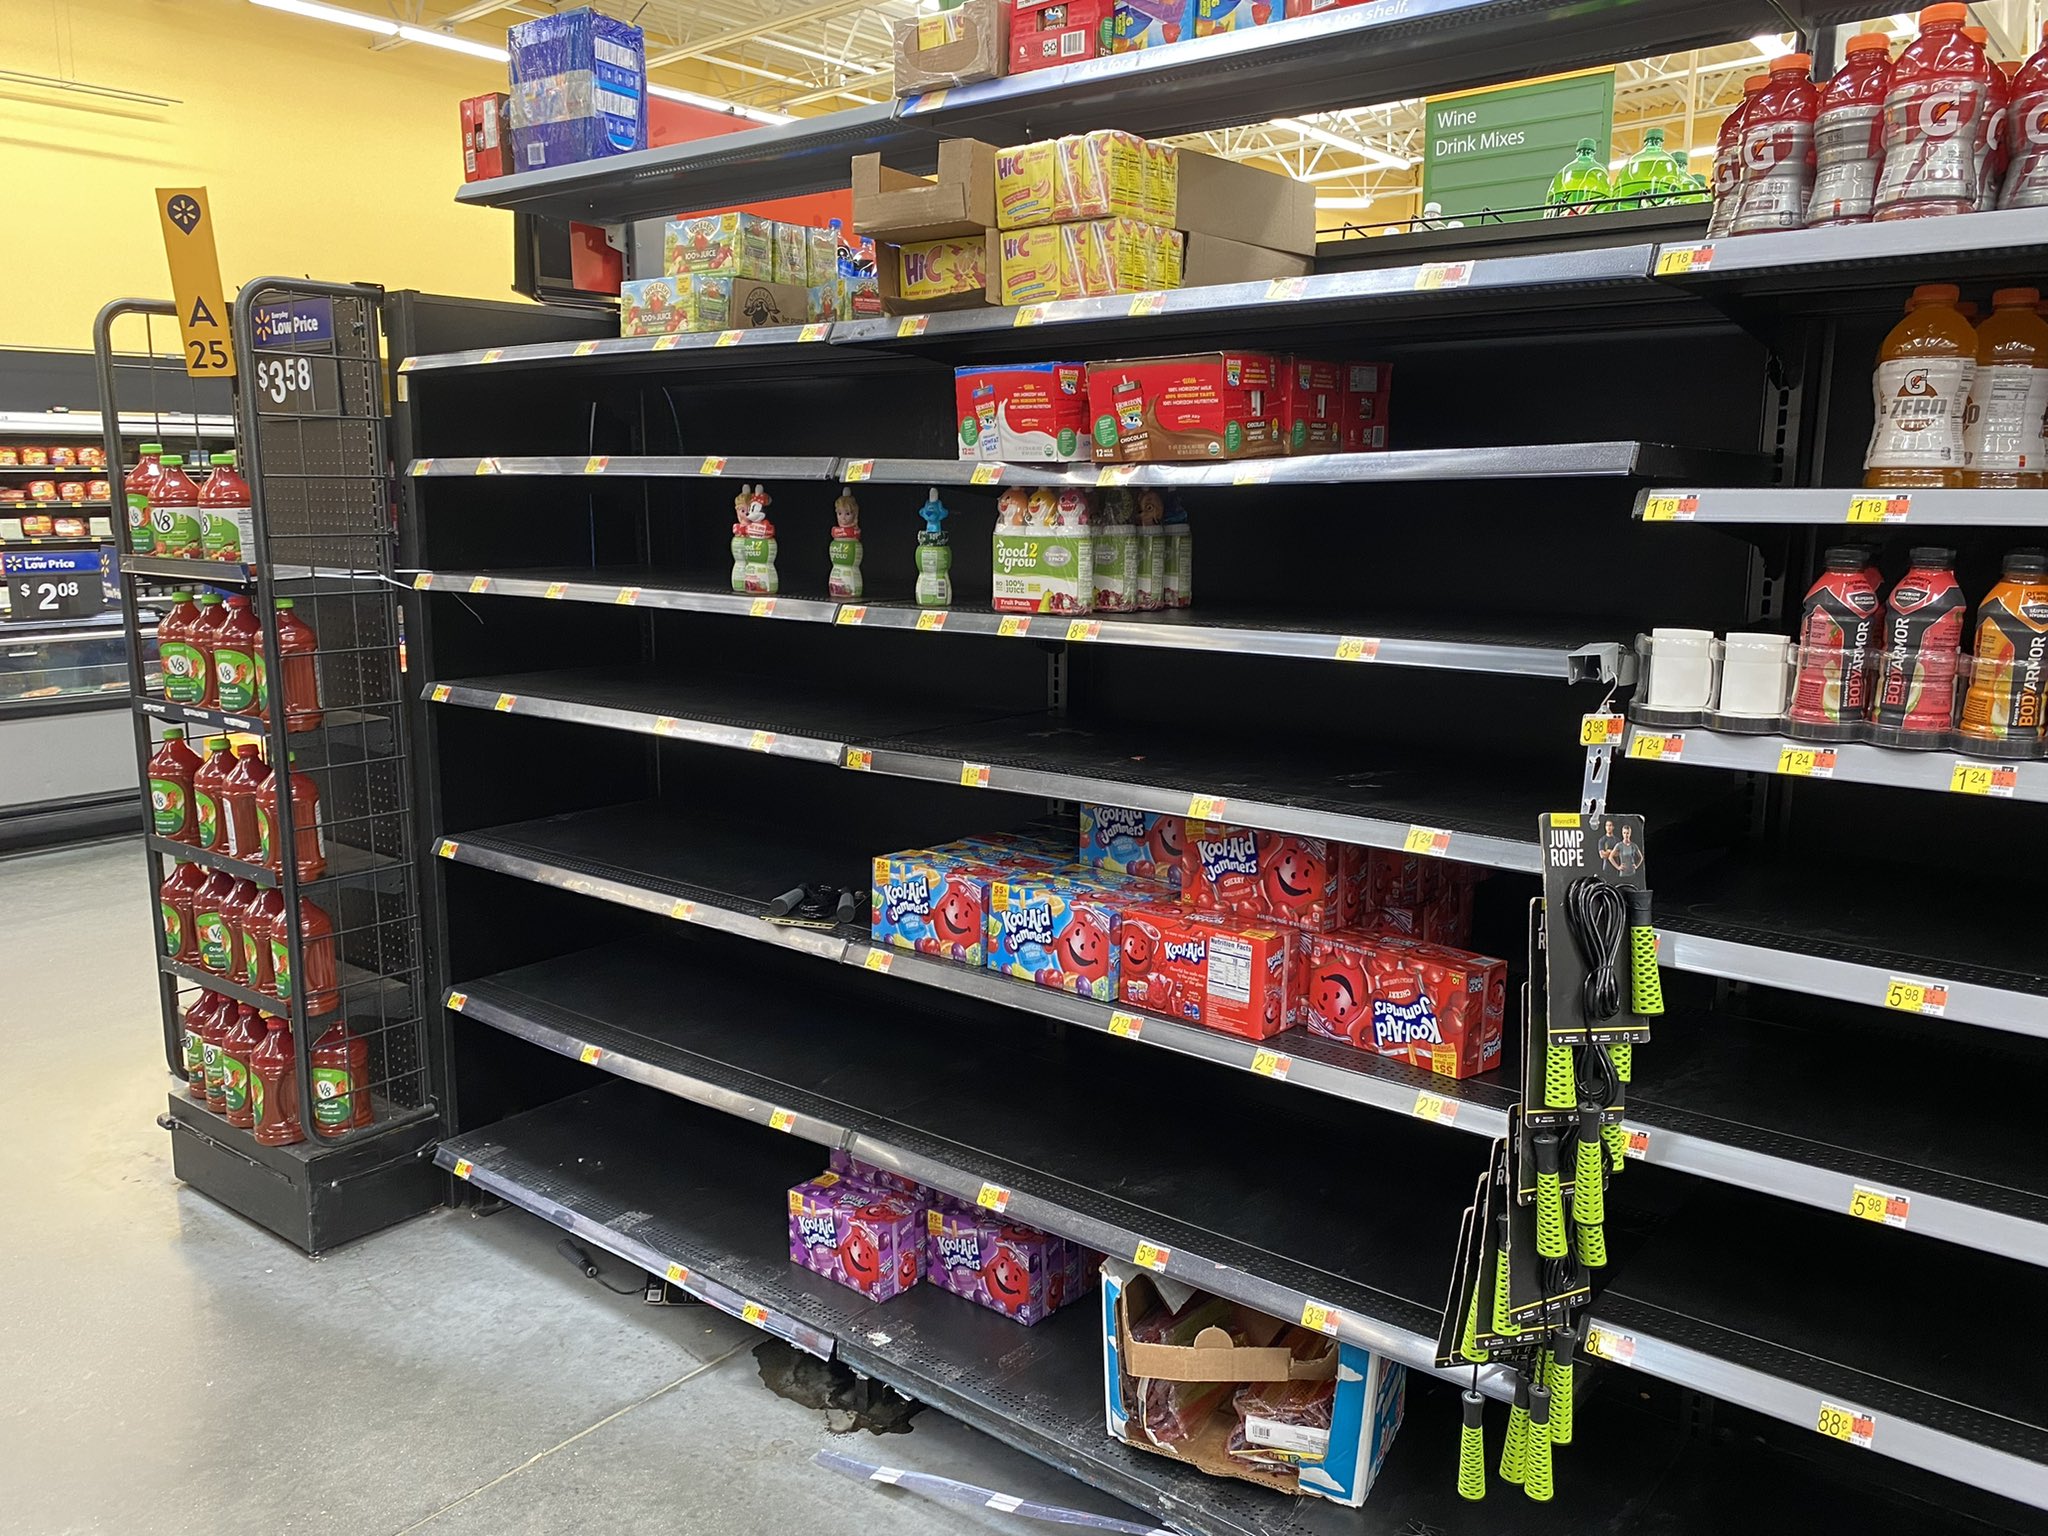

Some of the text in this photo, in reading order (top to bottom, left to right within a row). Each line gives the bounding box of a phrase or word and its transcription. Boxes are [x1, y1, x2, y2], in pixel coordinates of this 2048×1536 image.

[1437, 110, 1477, 129] Wine
[1919, 90, 1962, 137] G
[1436, 129, 1525, 157] Drink Mixes
[1744, 128, 1776, 171] G
[700, 250, 717, 259] JUICE
[189, 295, 219, 328] A
[656, 312, 672, 321] JUICE
[272, 315, 319, 336] Low Price
[188, 340, 229, 369] 25
[1904, 368, 1929, 396] G
[1890, 399, 1948, 420] ZERO
[985, 443, 997, 452] MILK
[1120, 432, 1149, 444] CHOCOLATE
[1095, 449, 1104, 458] 12
[153, 508, 171, 532] V8
[24, 559, 76, 570] Low Price
[1003, 558, 1037, 574] grow
[1005, 579, 1025, 587] 100%
[170, 657, 185, 673] V8
[1848, 621, 1870, 707] BODYARMOR
[1886, 617, 1910, 705] BODYARMOR
[219, 666, 231, 682] V8
[2018, 636, 2047, 727] BODYARMOR
[1100, 822, 1144, 845] Jammers
[1549, 830, 1584, 849] JUMP
[1196, 831, 1256, 865] Kool-Aid
[1551, 848, 1584, 867] ROPE
[1206, 859, 1258, 883] Jammers
[1223, 876, 1246, 887] CHERRY
[883, 876, 929, 906] Kool-Aid
[891, 901, 930, 922] Jammers
[1001, 903, 1051, 934] Kool-Aid
[1010, 929, 1052, 950] Jammers
[1211, 937, 1252, 953] Nutrition Facts
[1164, 940, 1206, 964] Kool-Aid
[1374, 995, 1431, 1021] Jammers
[1375, 1014, 1443, 1047] Kool-Aid
[318, 1082, 331, 1097] V8
[798, 1215, 836, 1236] Kool-Aid
[804, 1233, 837, 1249] Jammers
[937, 1235, 980, 1260] Kool-Aid
[944, 1257, 981, 1271] Jammers
